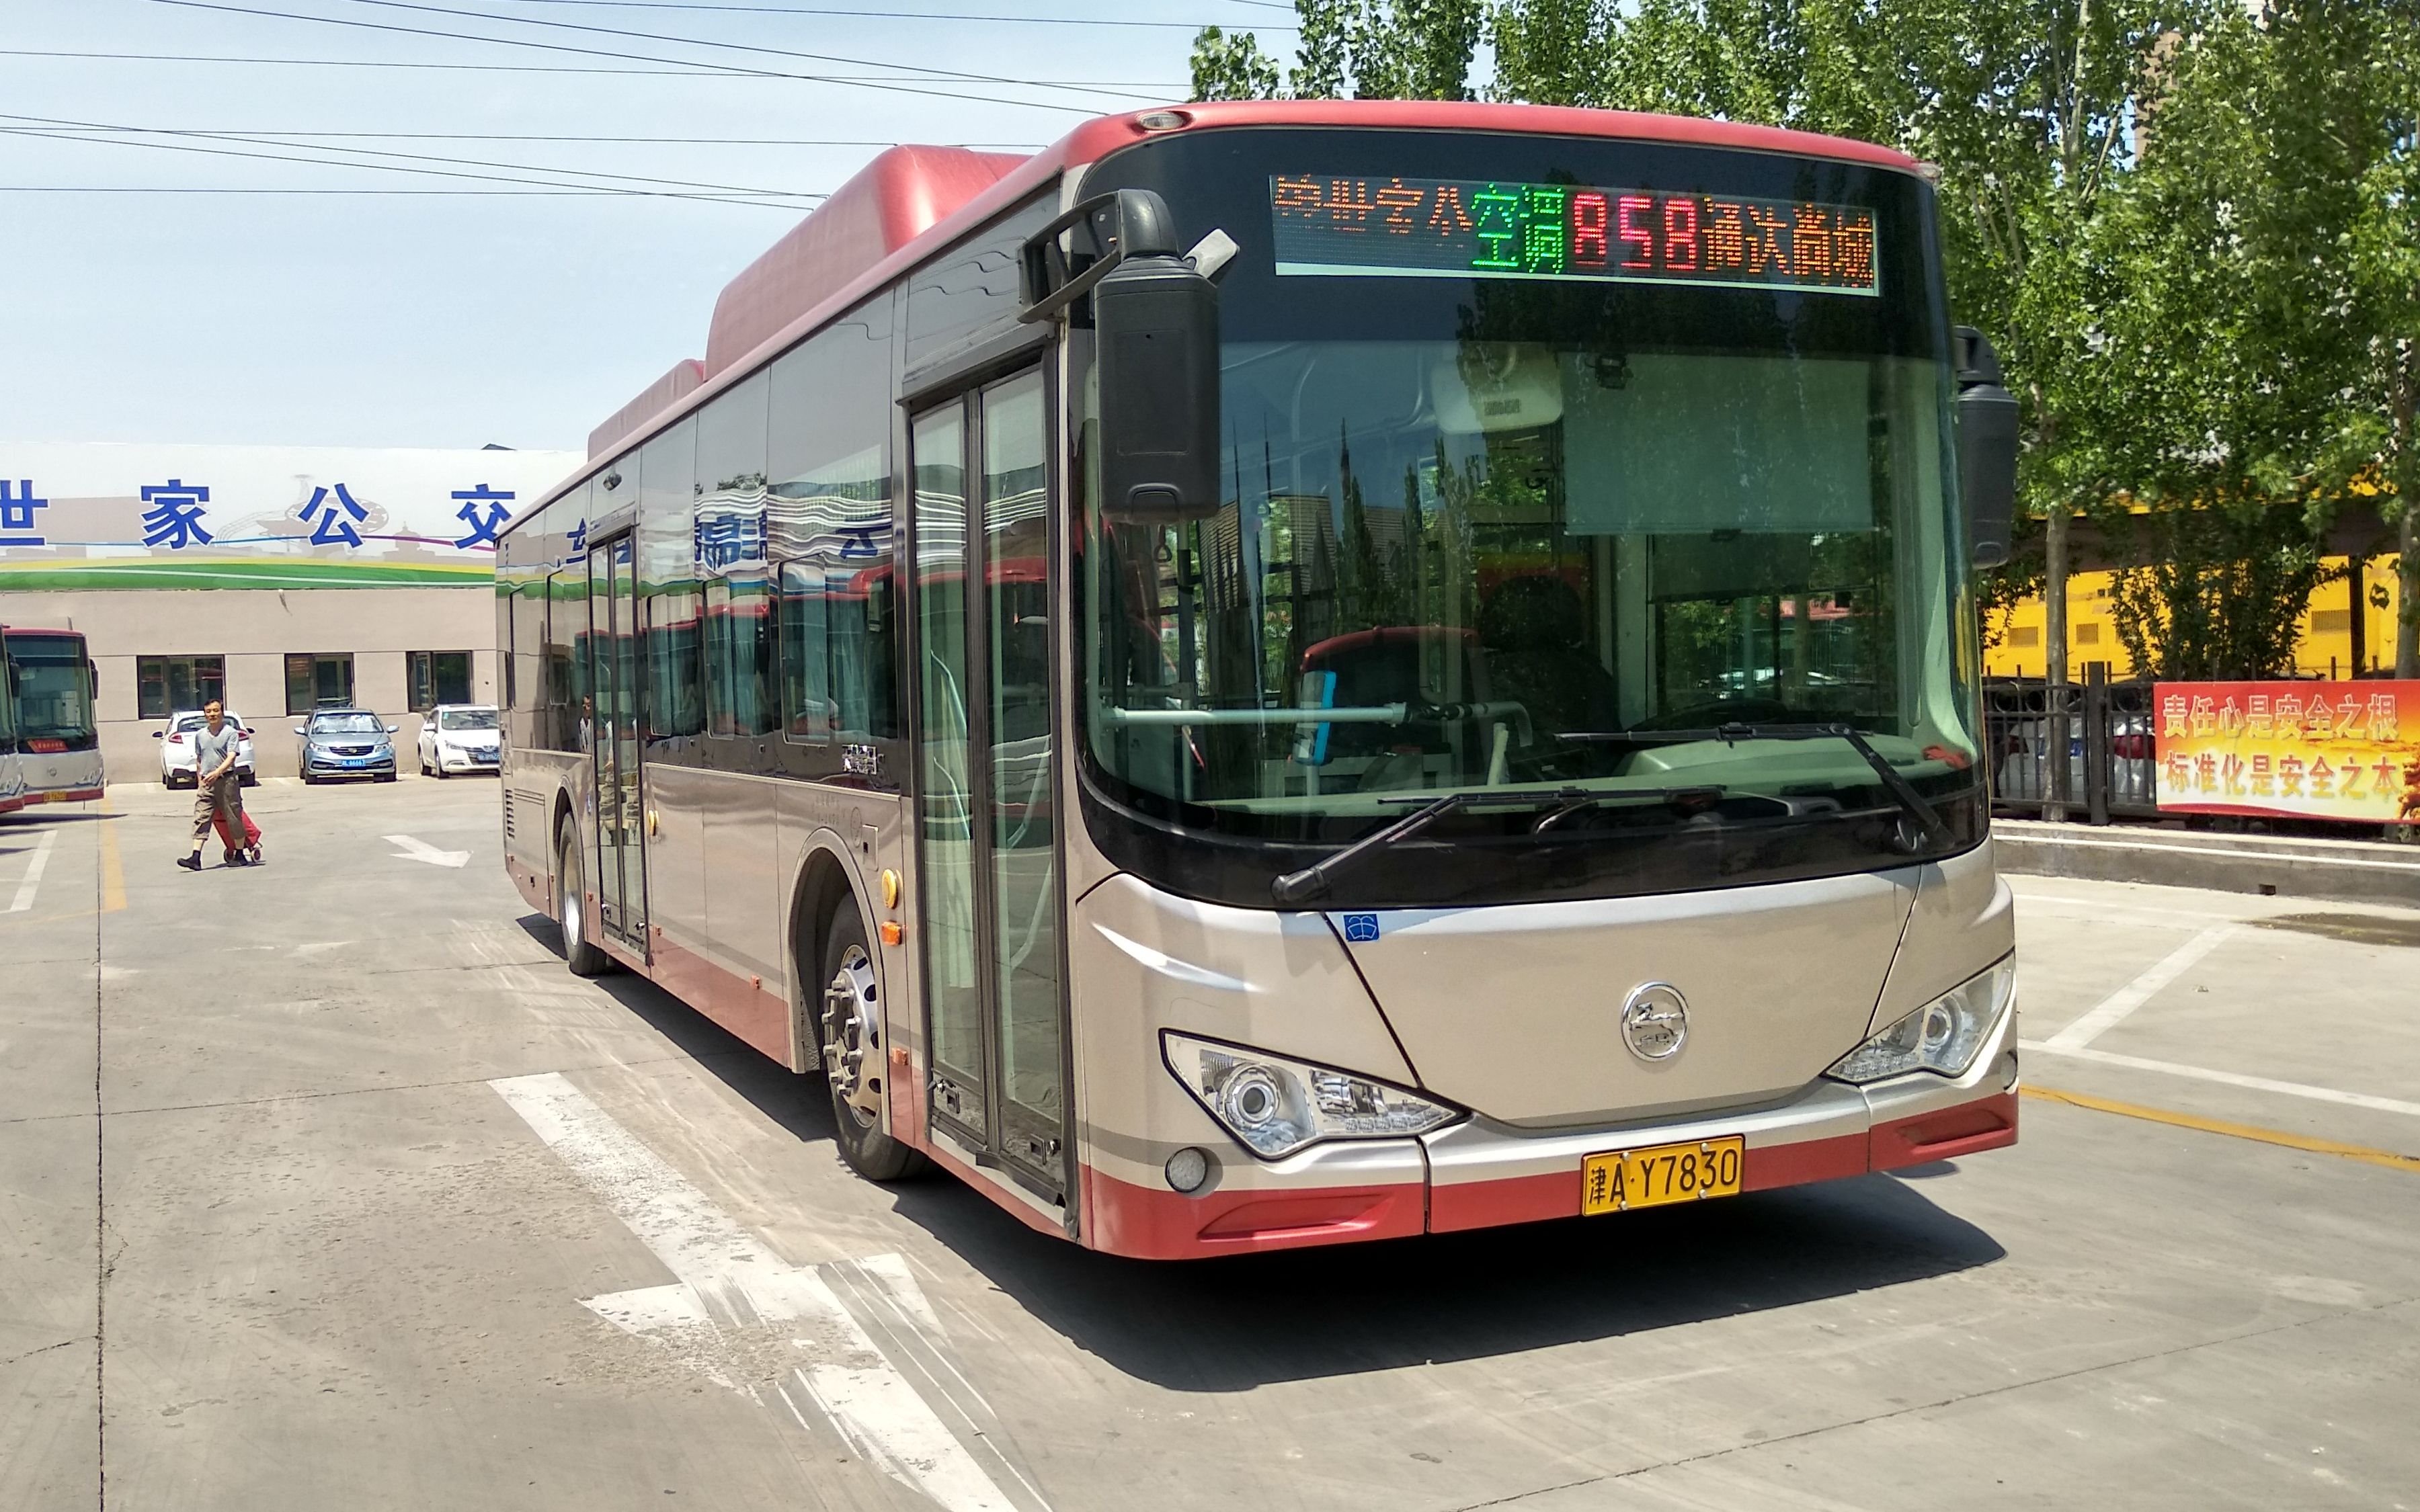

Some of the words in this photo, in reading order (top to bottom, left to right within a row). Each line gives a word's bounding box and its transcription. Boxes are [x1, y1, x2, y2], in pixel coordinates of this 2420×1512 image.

[1471, 183, 1565, 274] 空调
[1574, 192, 1697, 271] 858
[0, 478, 516, 549] 世家公交
[2162, 694, 2399, 741] 责任心是安全之根
[2165, 750, 2398, 799] 标准化是安全之本
